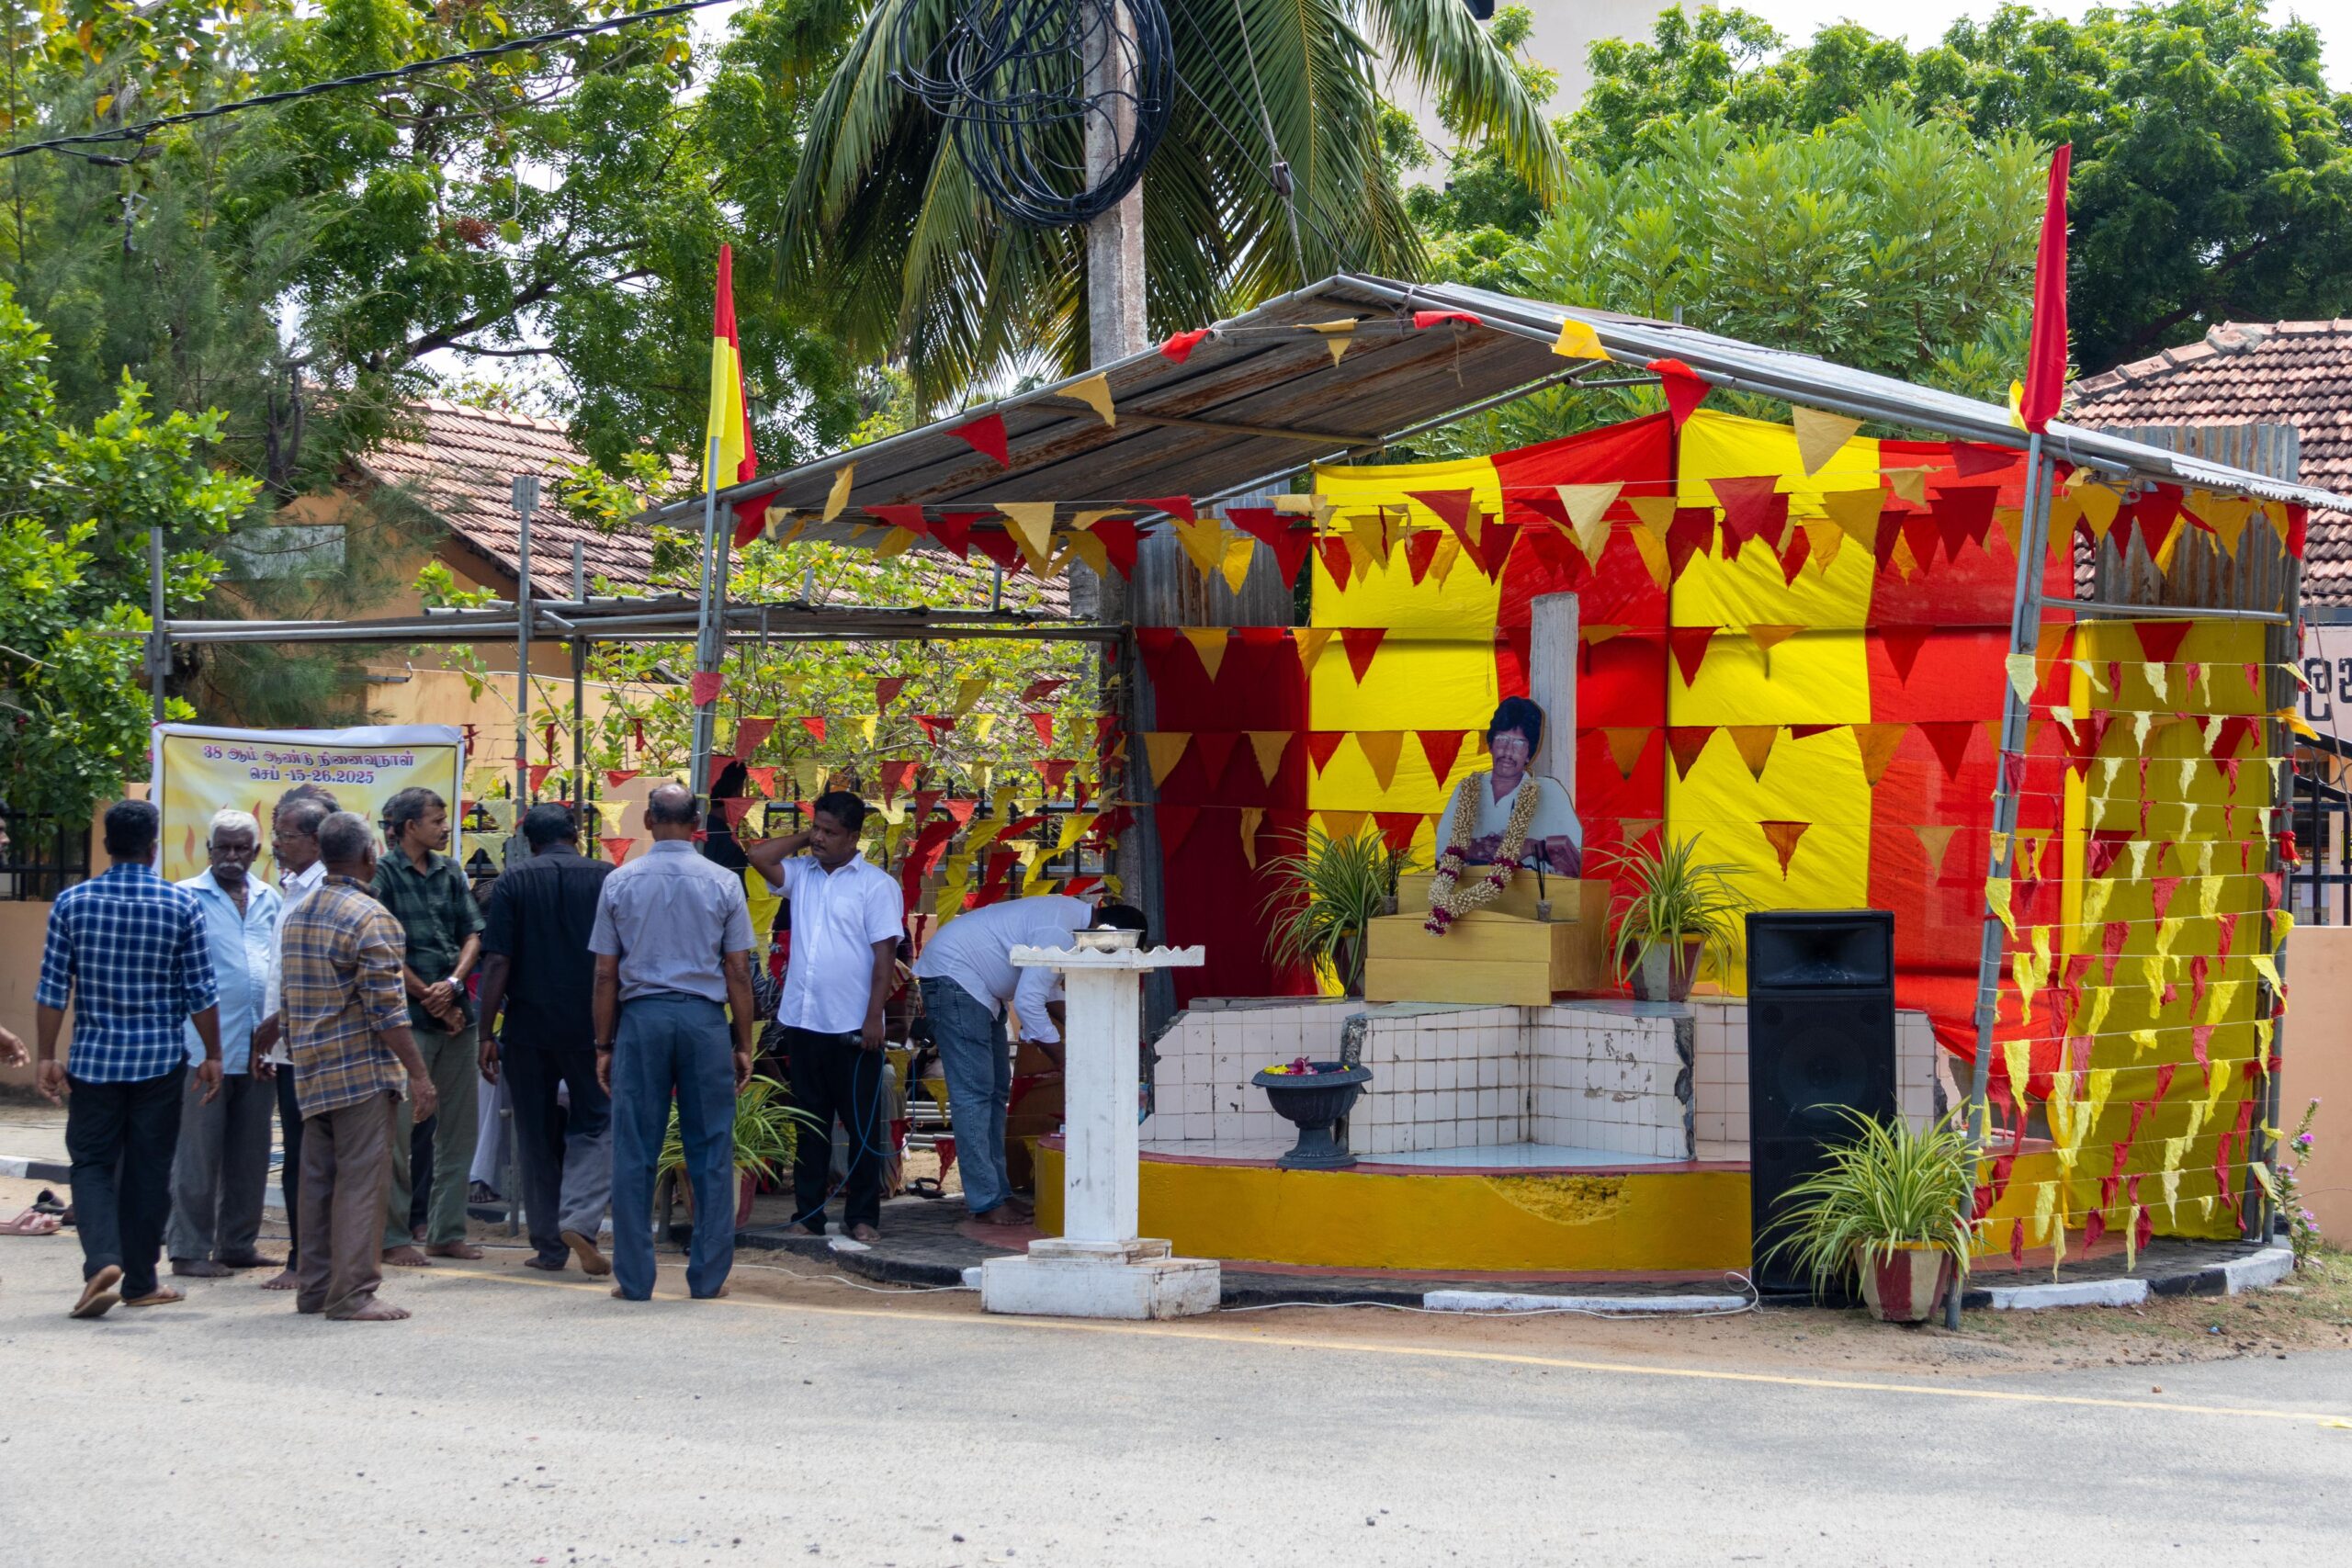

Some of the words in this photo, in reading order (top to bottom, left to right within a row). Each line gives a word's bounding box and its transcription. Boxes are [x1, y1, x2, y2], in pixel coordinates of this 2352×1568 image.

[203, 745, 223, 760] 38
[228, 746, 258, 762] ஆம்
[264, 749, 314, 766] ஆண்டு
[317, 750, 414, 768] நினைவுநாள்
[249, 764, 280, 781] செப்
